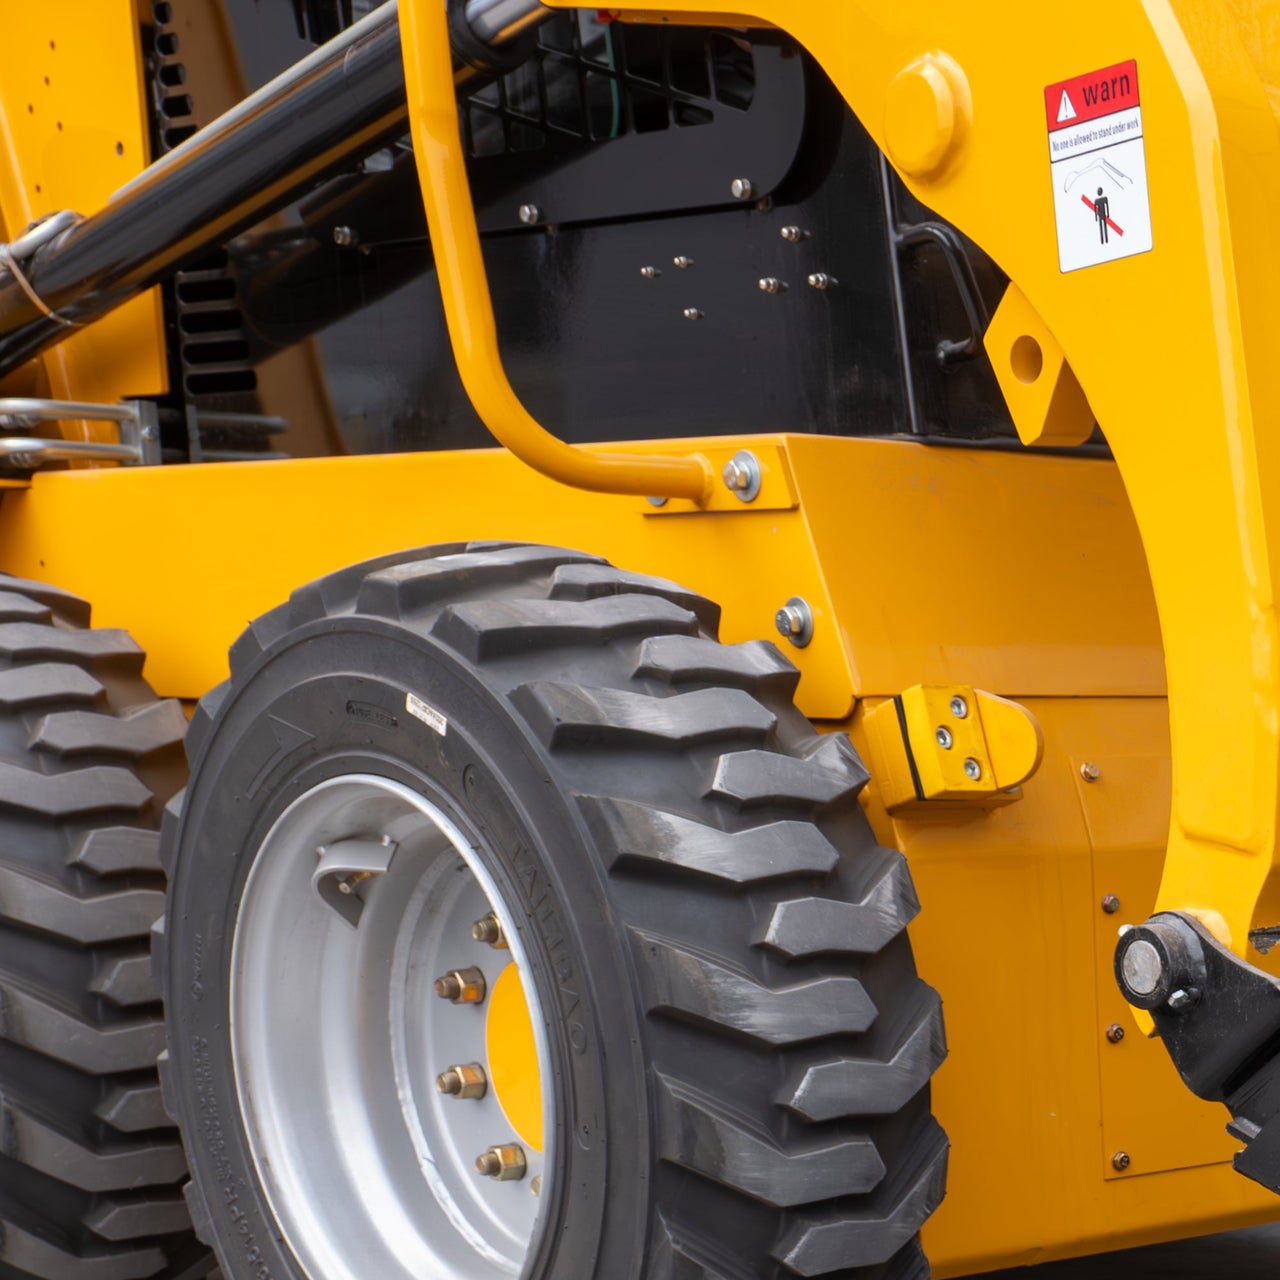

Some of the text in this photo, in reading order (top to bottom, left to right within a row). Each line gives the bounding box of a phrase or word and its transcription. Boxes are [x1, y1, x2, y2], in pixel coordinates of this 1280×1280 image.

[1083, 74, 1130, 107] warn
[1052, 140, 1060, 152] No
[1060, 139, 1069, 149] one
[1073, 130, 1093, 146] allowed
[1098, 125, 1113, 139] stand
[1112, 121, 1126, 134] under
[1126, 117, 1139, 130] work
